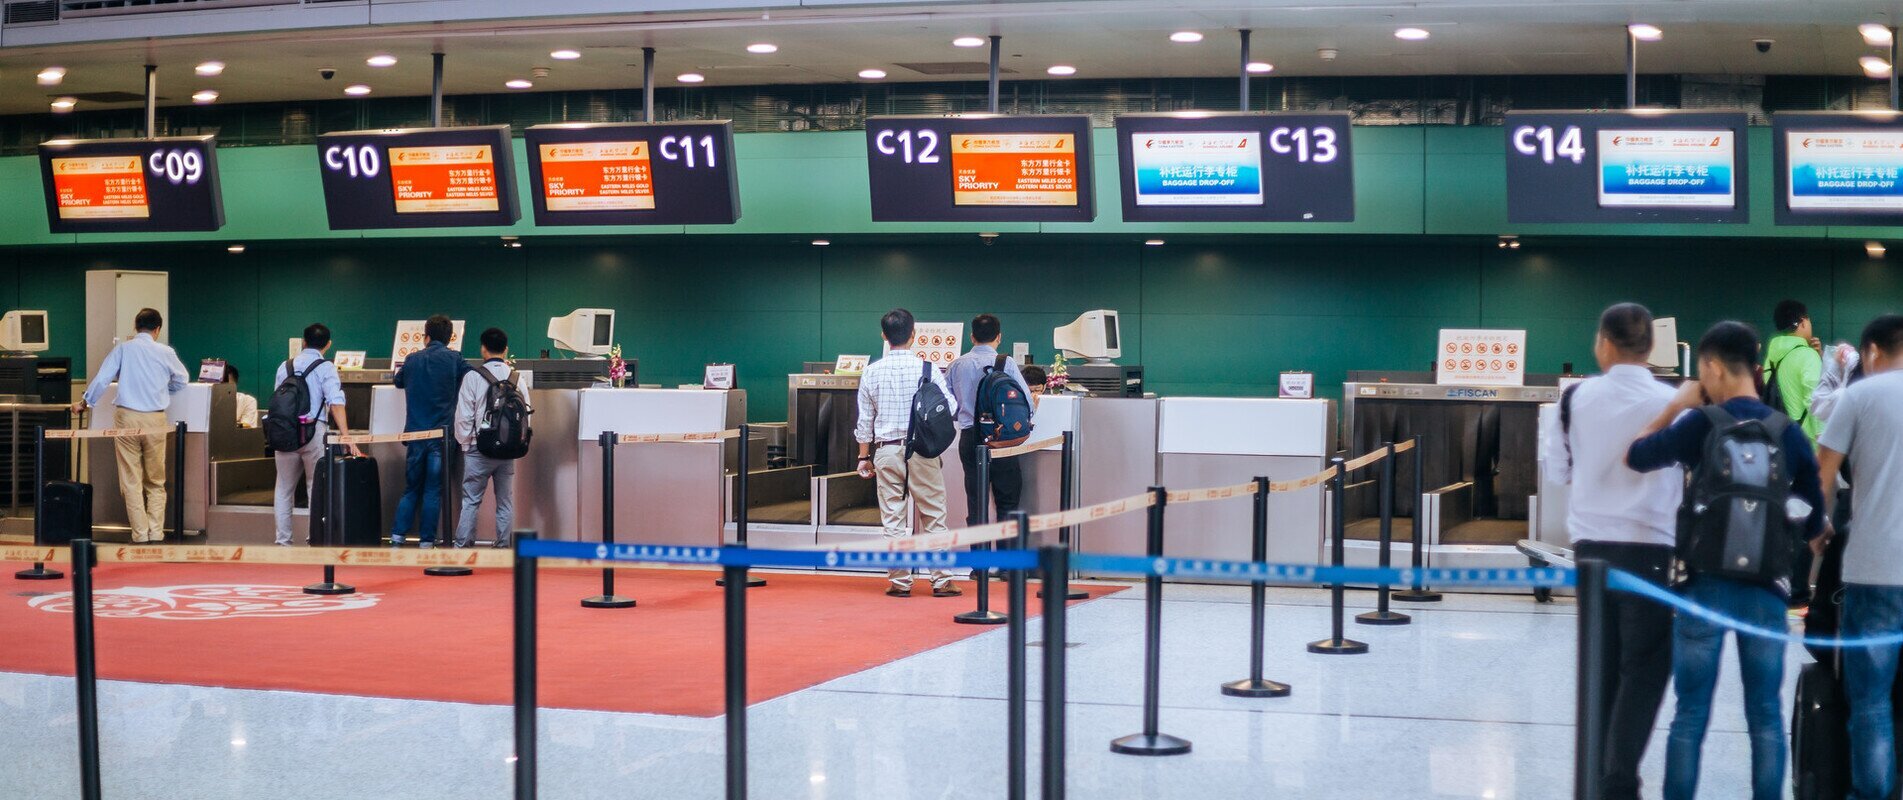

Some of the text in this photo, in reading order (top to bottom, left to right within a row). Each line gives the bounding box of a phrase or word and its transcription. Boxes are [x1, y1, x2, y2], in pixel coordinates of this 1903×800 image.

[326, 145, 380, 178] C10
[659, 135, 716, 169] C11
[876, 129, 940, 164] C12
[1269, 127, 1338, 163] C13
[1513, 126, 1586, 164] C14
[150, 150, 203, 183] C09
[1159, 165, 1238, 178] 补托运行李专柜
[1625, 164, 1708, 177] 补托运行李专柜
[1818, 180, 1895, 188] BAGGAGE DROP-OFF
[1457, 389, 1498, 398] FISCAN
